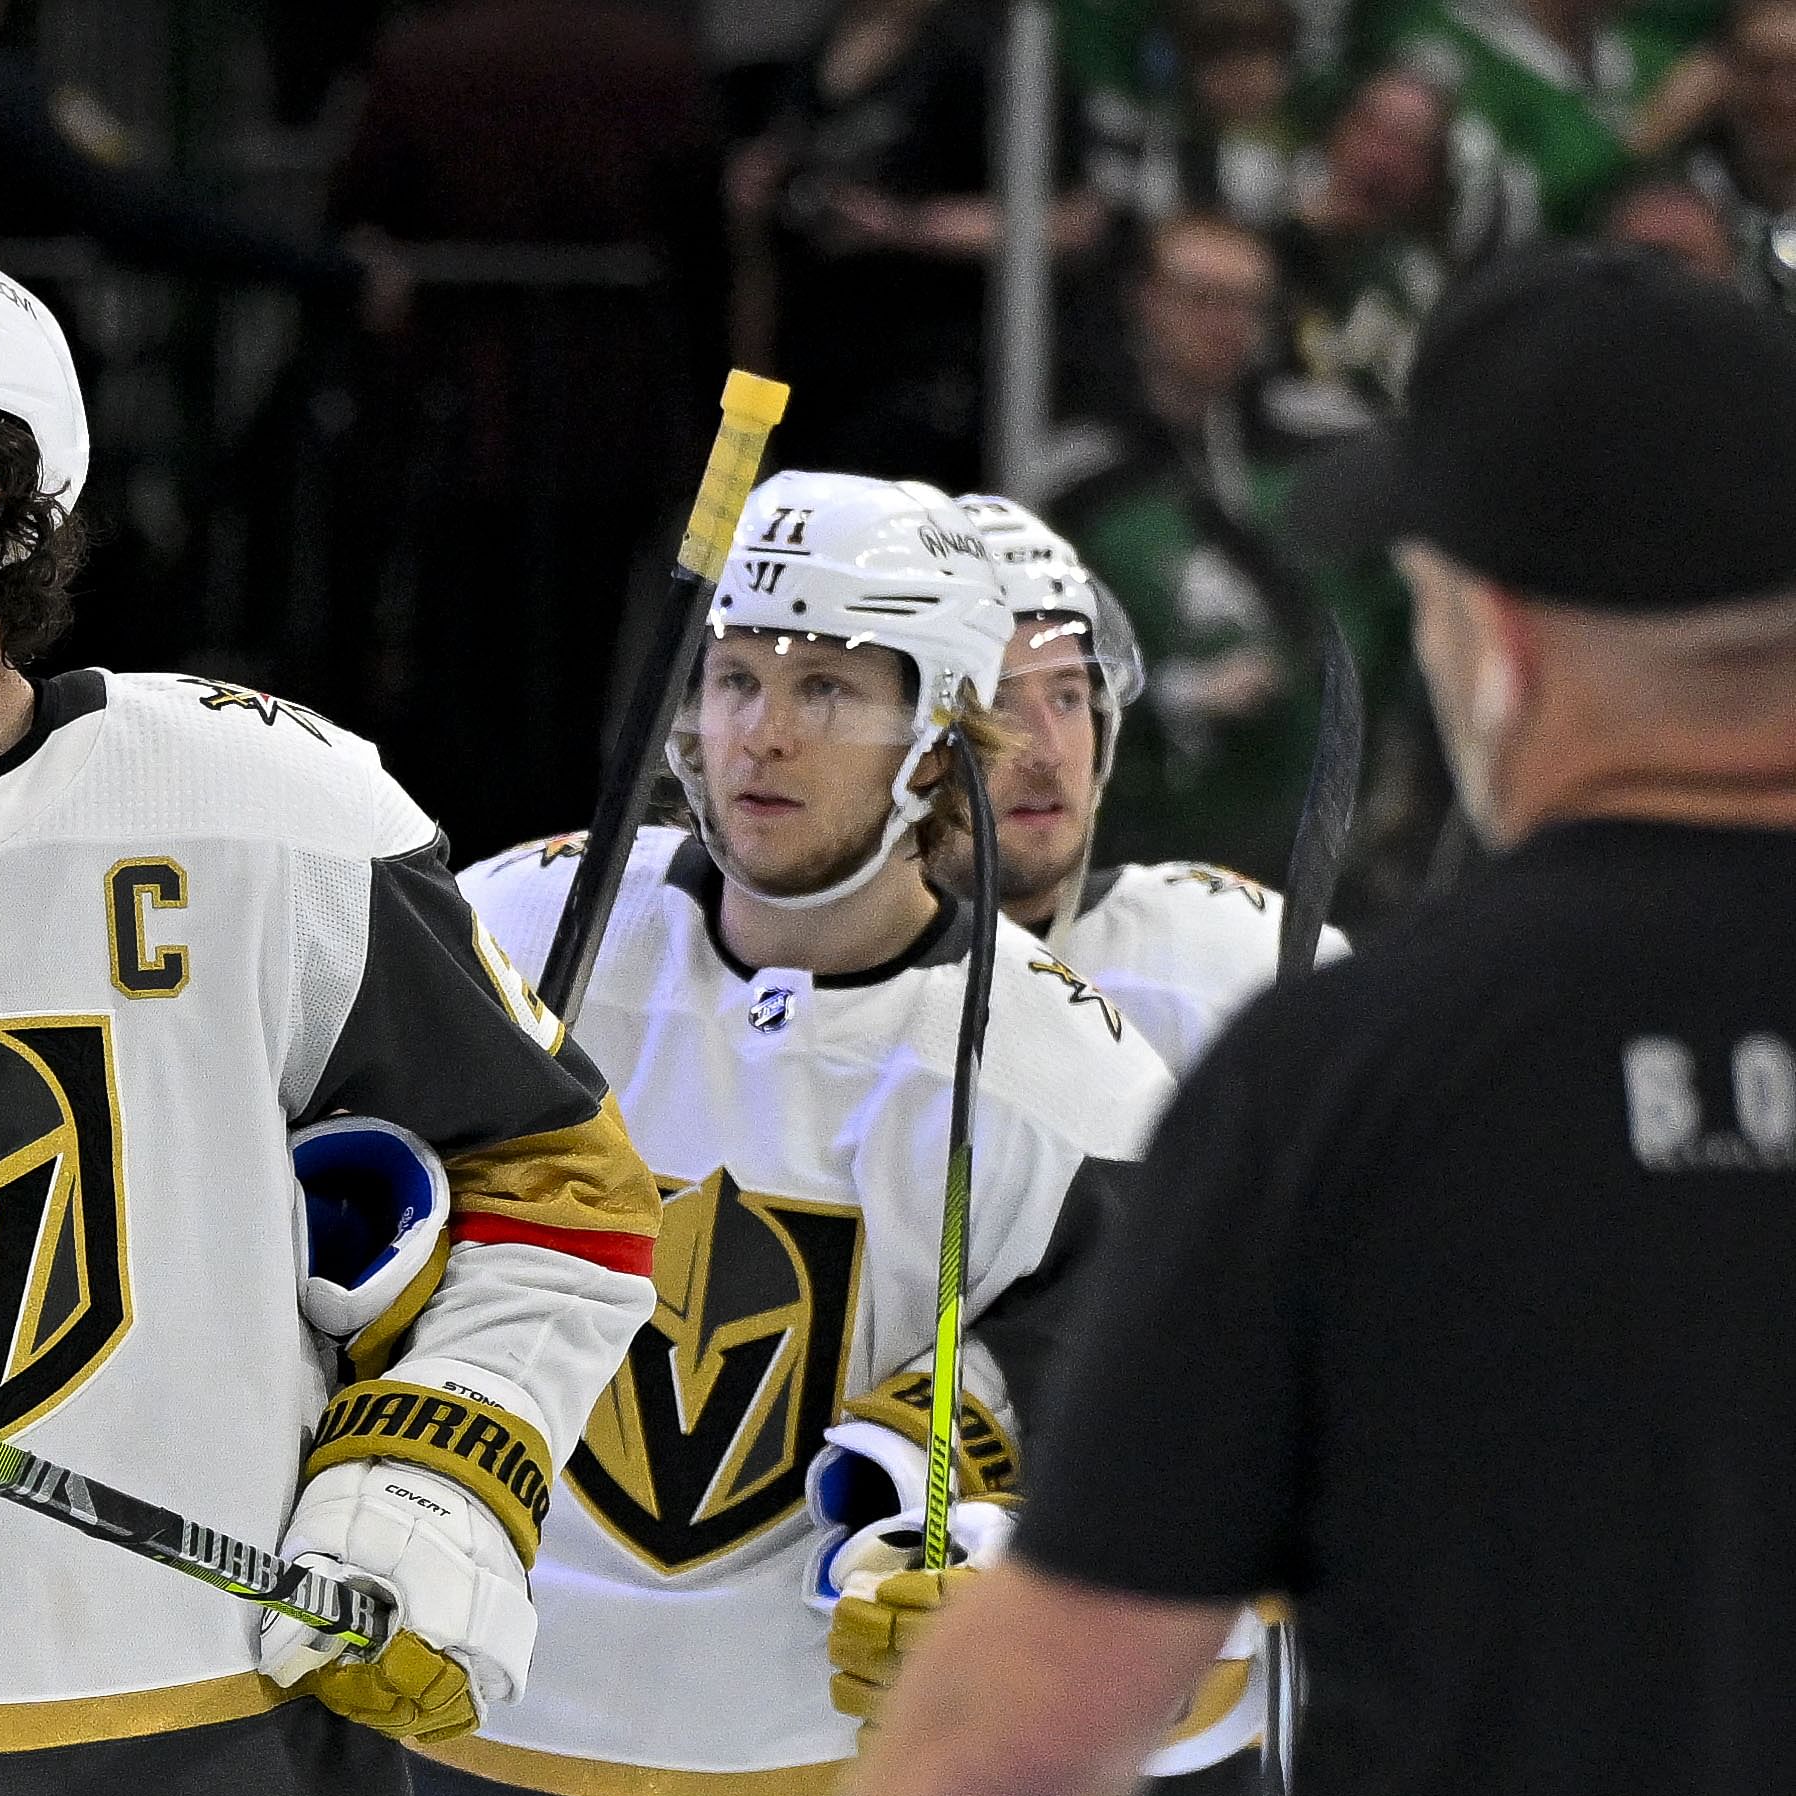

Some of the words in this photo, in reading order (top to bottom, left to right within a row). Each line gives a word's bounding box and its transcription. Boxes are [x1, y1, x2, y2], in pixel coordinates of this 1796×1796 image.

[759, 508, 814, 545] 71
[104, 855, 190, 1000] C
[384, 1484, 451, 1517] COVERT
